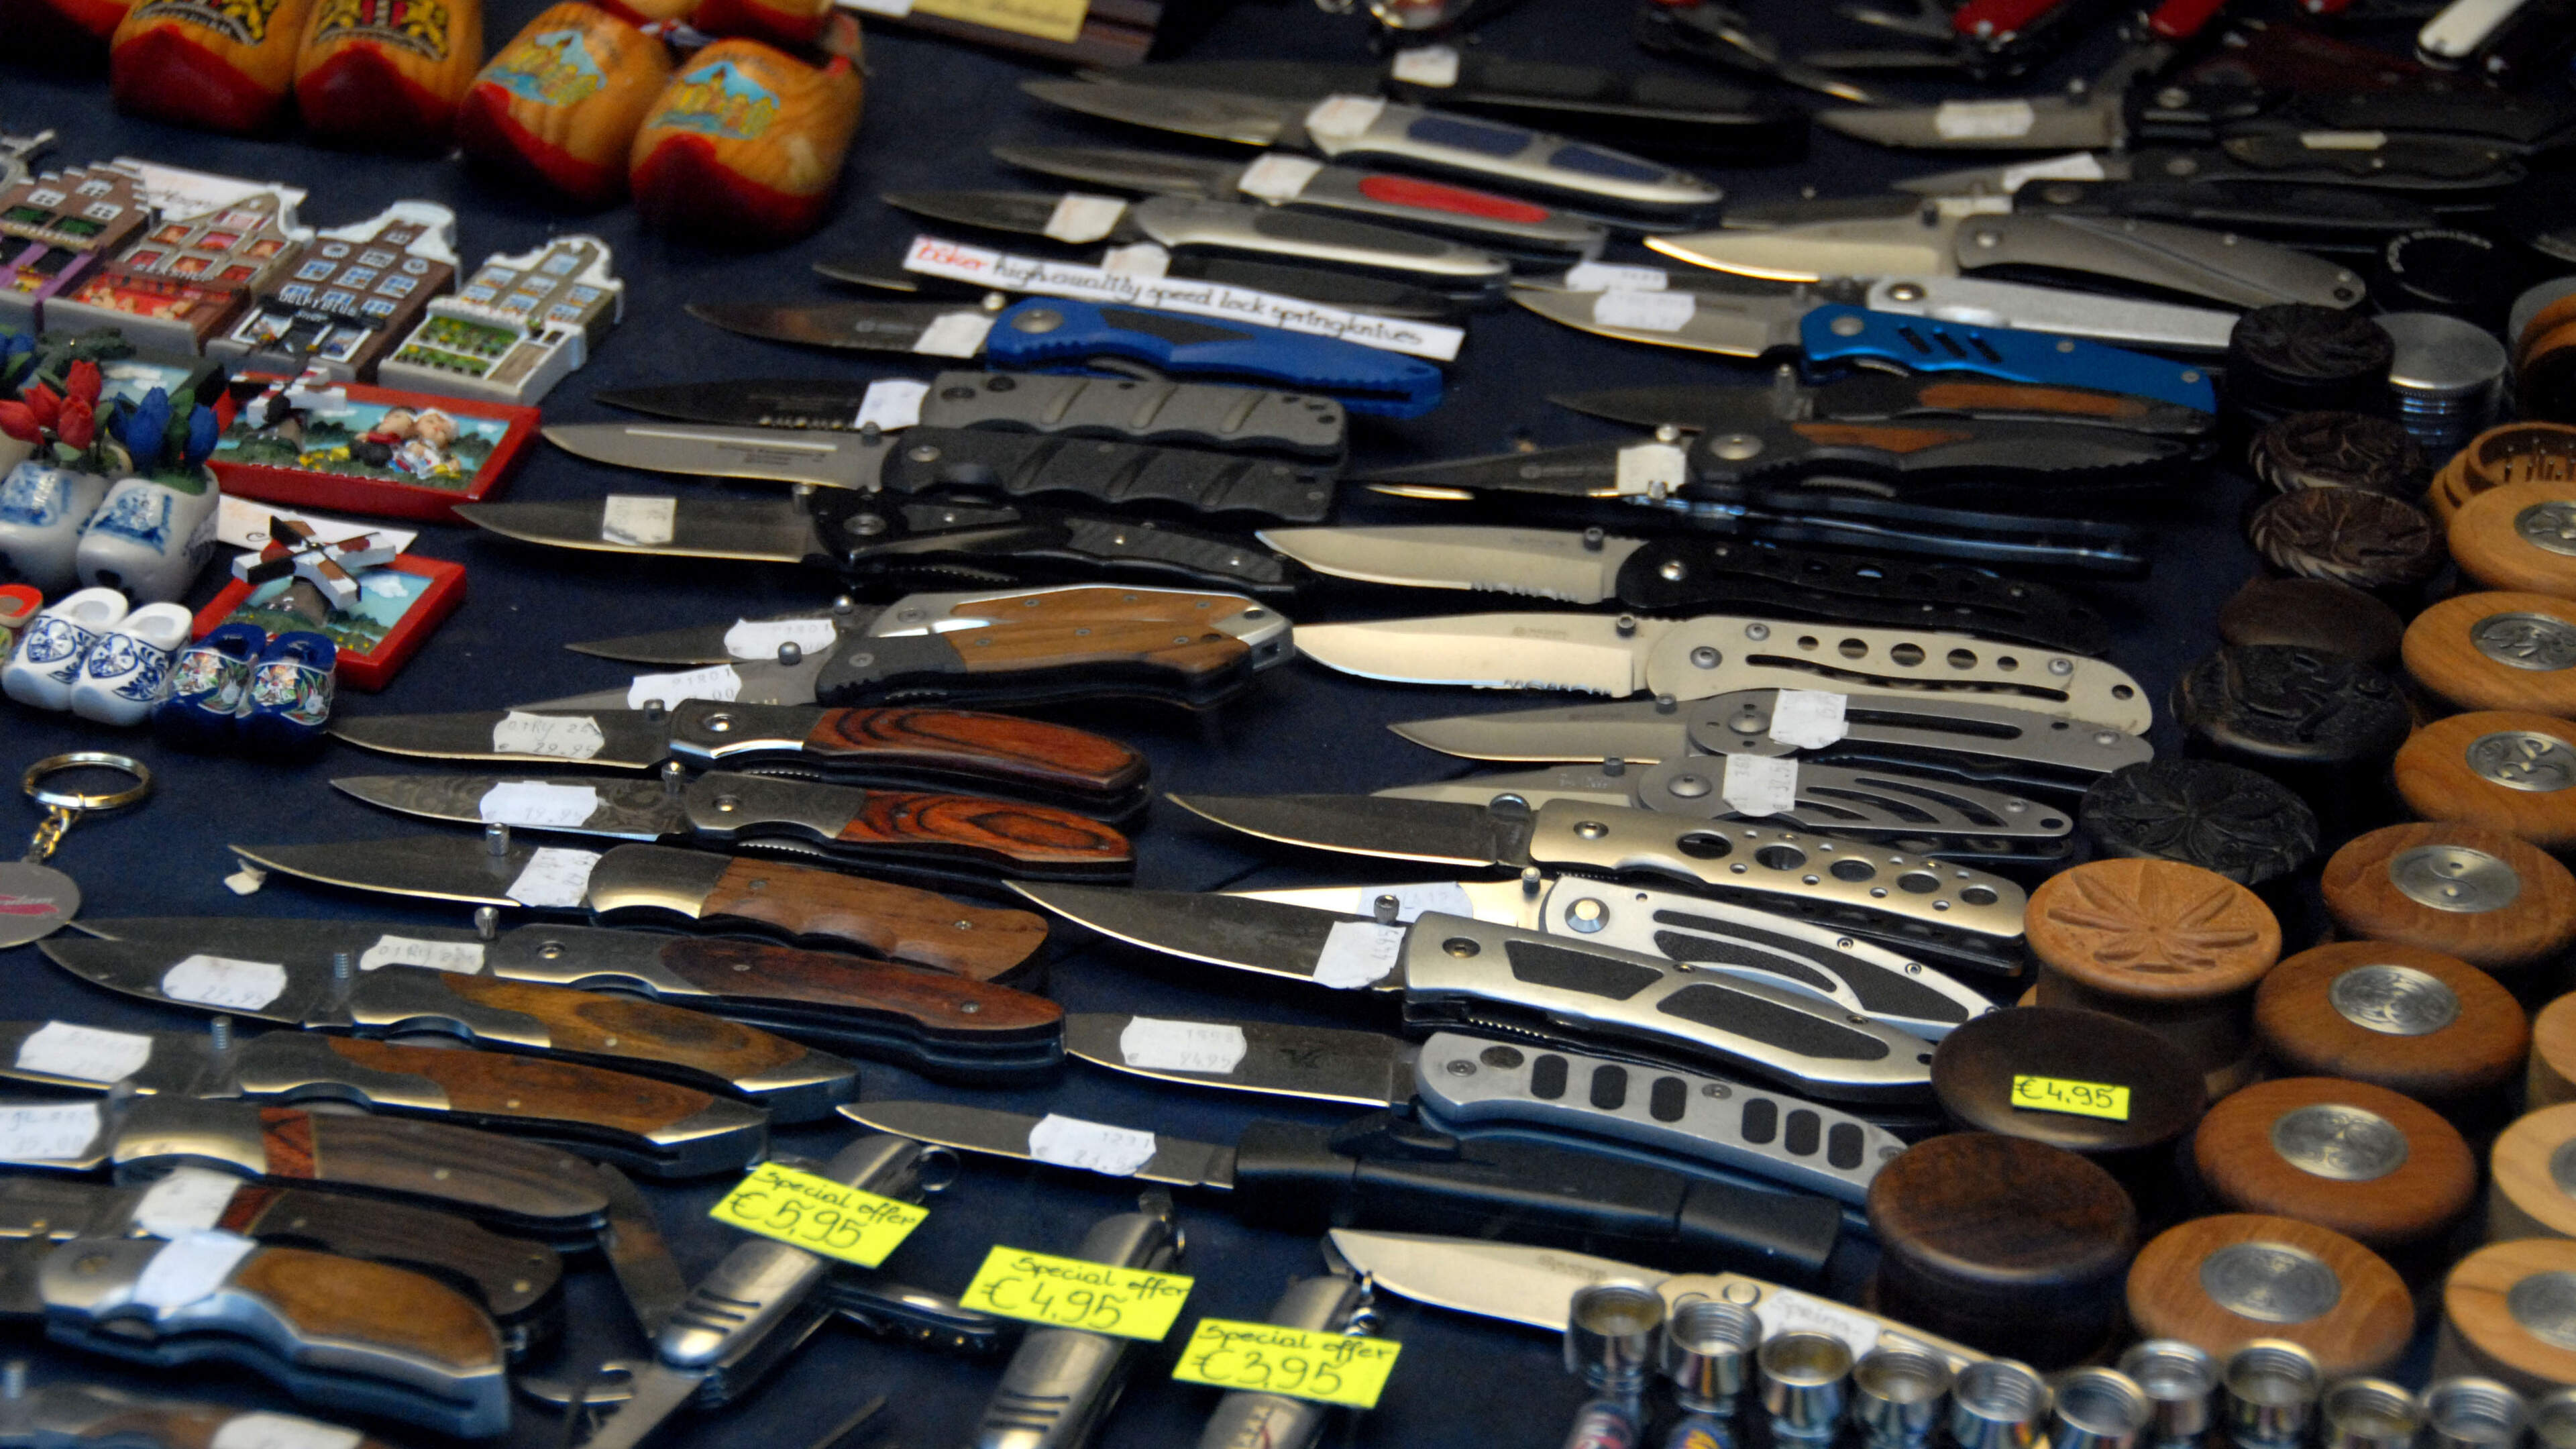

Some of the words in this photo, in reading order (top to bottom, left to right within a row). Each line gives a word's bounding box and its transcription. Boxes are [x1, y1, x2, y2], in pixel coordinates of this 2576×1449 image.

[1144, 286, 1212, 308] speed
[1220, 290, 1266, 314] lock
[754, 1172, 851, 1209] Special
[857, 1202, 916, 1225] offer
[1010, 1256, 1116, 1287] Special
[1126, 1276, 1191, 1300] offer
[1197, 1325, 1312, 1349] Special
[1322, 1339, 1395, 1363] offer
